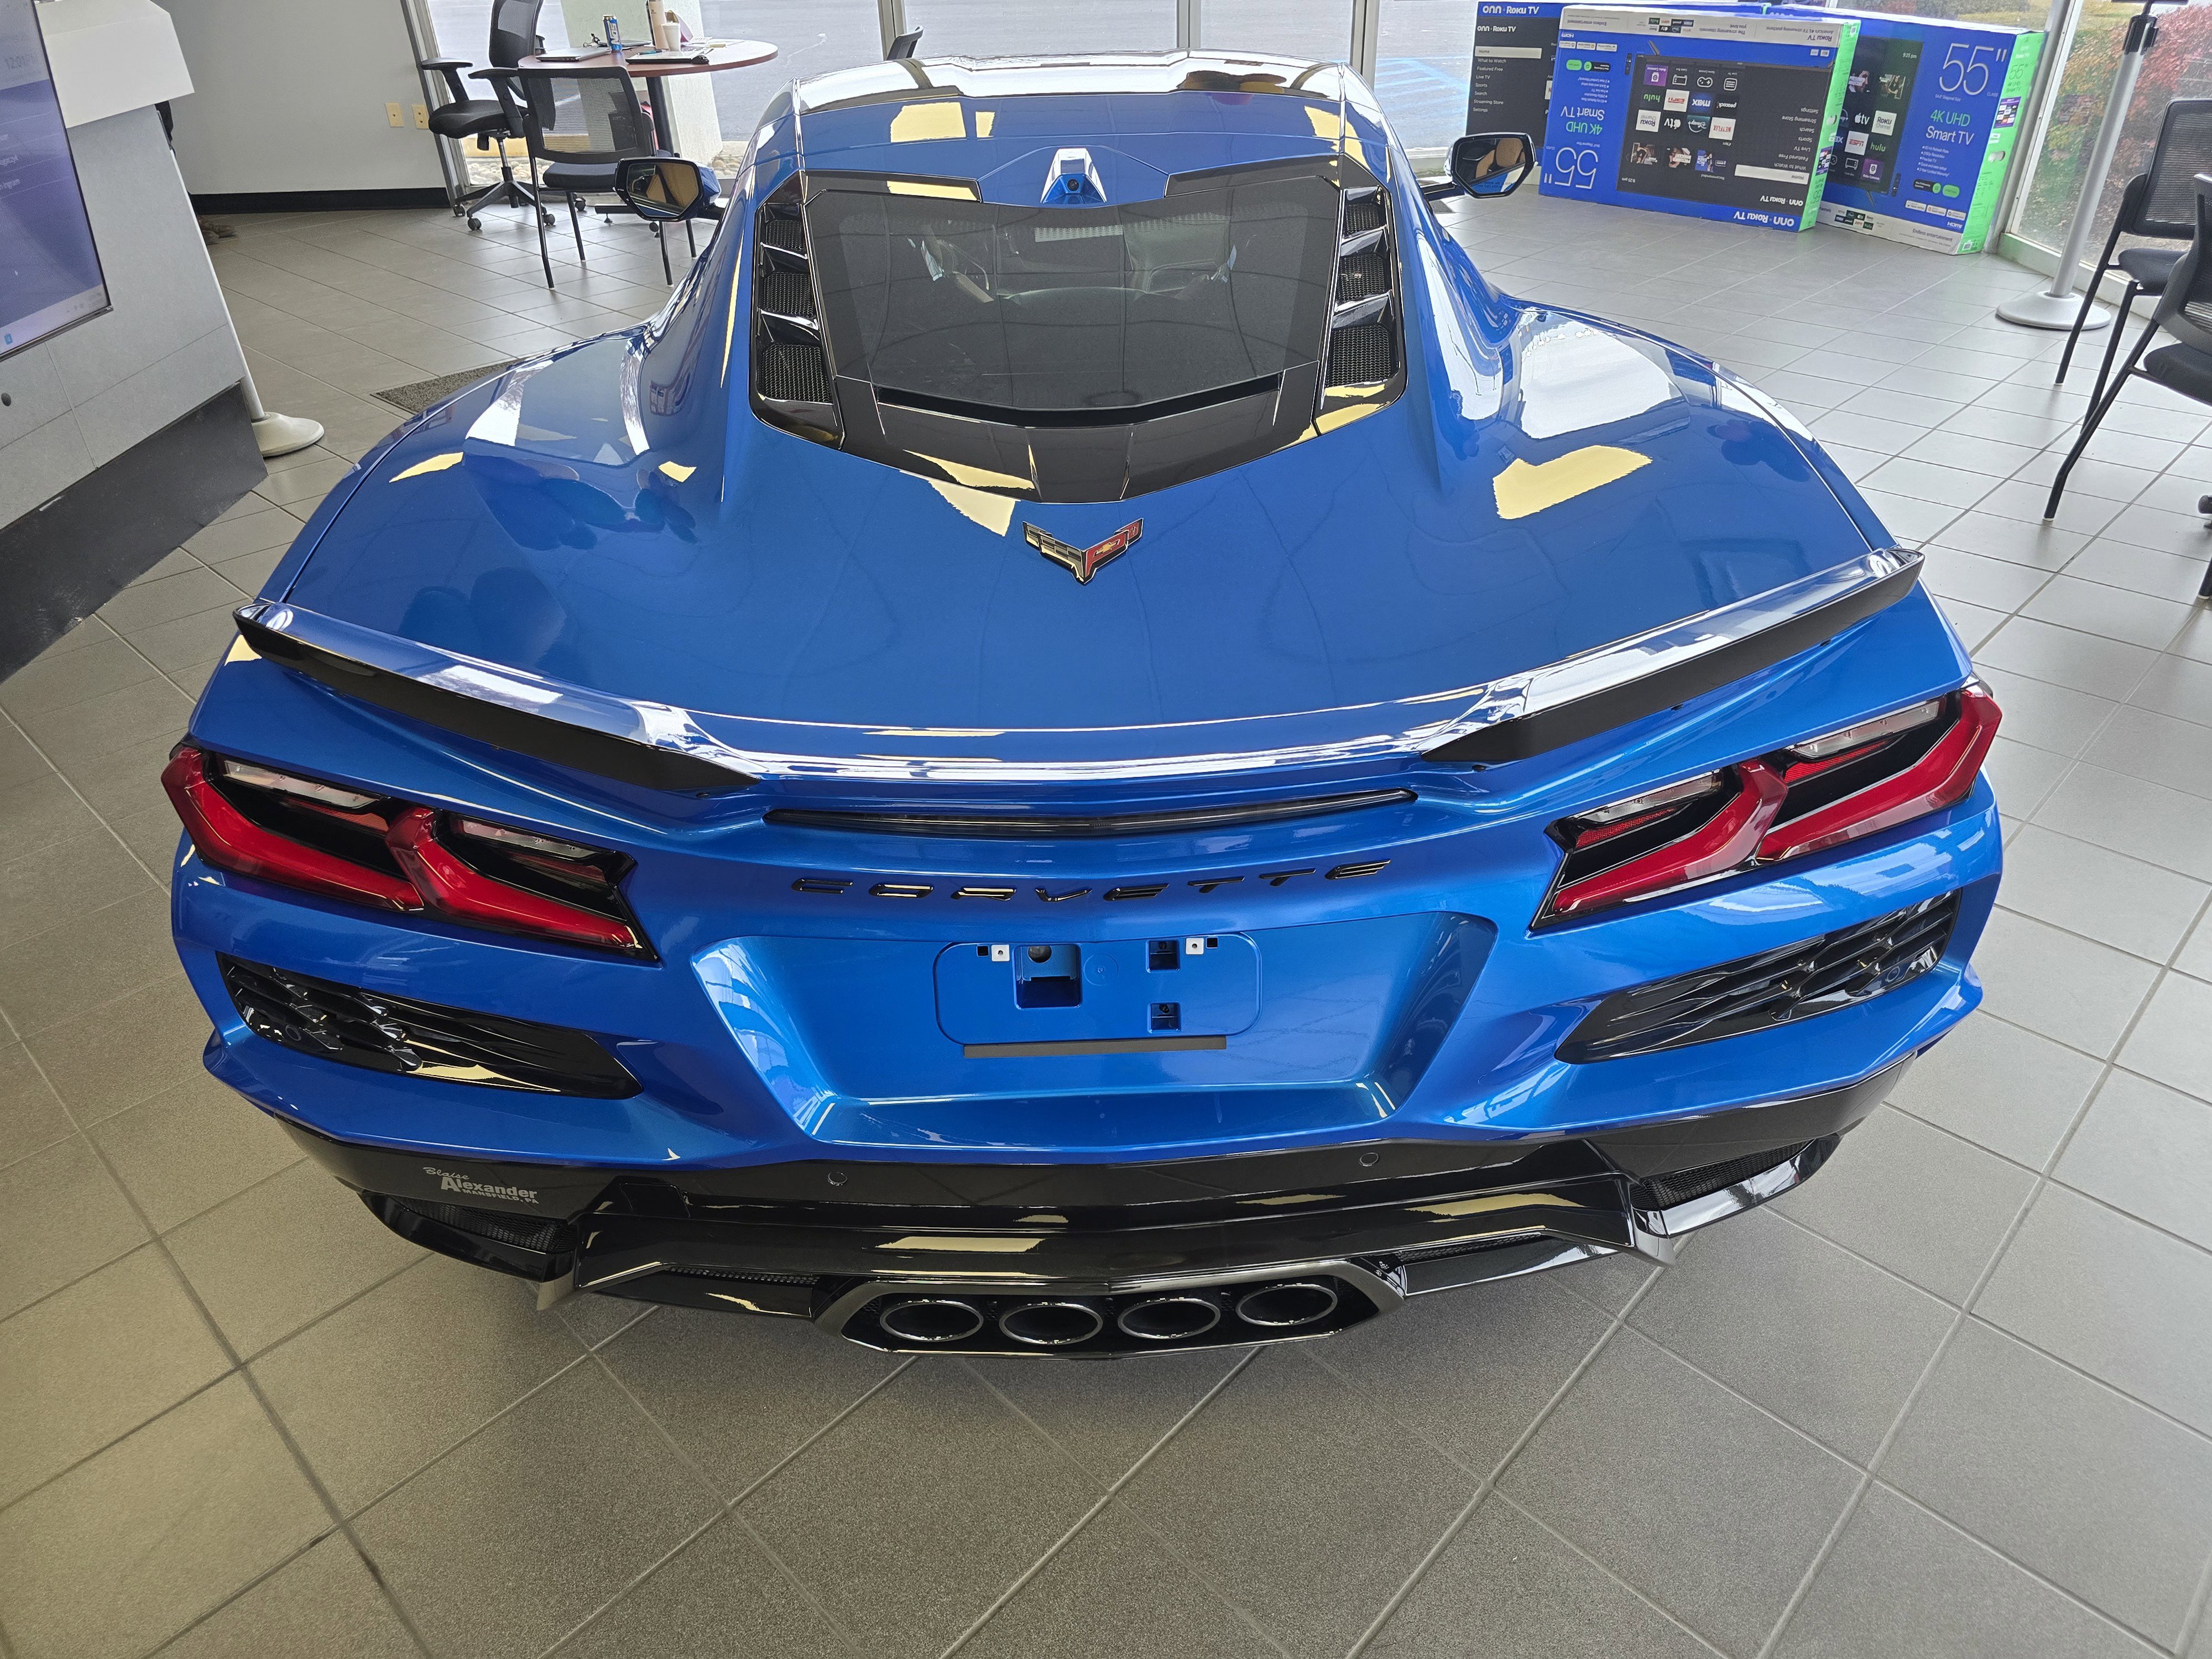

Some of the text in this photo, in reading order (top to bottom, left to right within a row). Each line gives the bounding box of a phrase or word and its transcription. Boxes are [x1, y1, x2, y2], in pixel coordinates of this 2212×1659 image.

[1483, 6, 1502, 14] onn
[1528, 6, 1540, 14] TV
[1939, 43, 2007, 95] 55"
[1644, 93, 1661, 102] hulu
[1692, 98, 1710, 107] max
[1561, 106, 1605, 121] Smart TV
[1931, 109, 1970, 127] 4K UHD
[1566, 121, 1603, 135] 4K UHD
[1713, 124, 1731, 133] NETFLIX
[1926, 126, 1974, 145] Smart TV
[1870, 142, 1886, 152] hulu
[1544, 147, 1599, 190] 55"
[1770, 196, 1786, 205] Roku
[1733, 211, 1794, 227] onn Roku TV
[1912, 228, 1926, 237] Endless
[1927, 231, 1953, 242] entertainment
[791, 859, 1391, 902] CORVETTE
[422, 1166, 470, 1180] Blaise
[441, 1176, 538, 1198] Alexander
